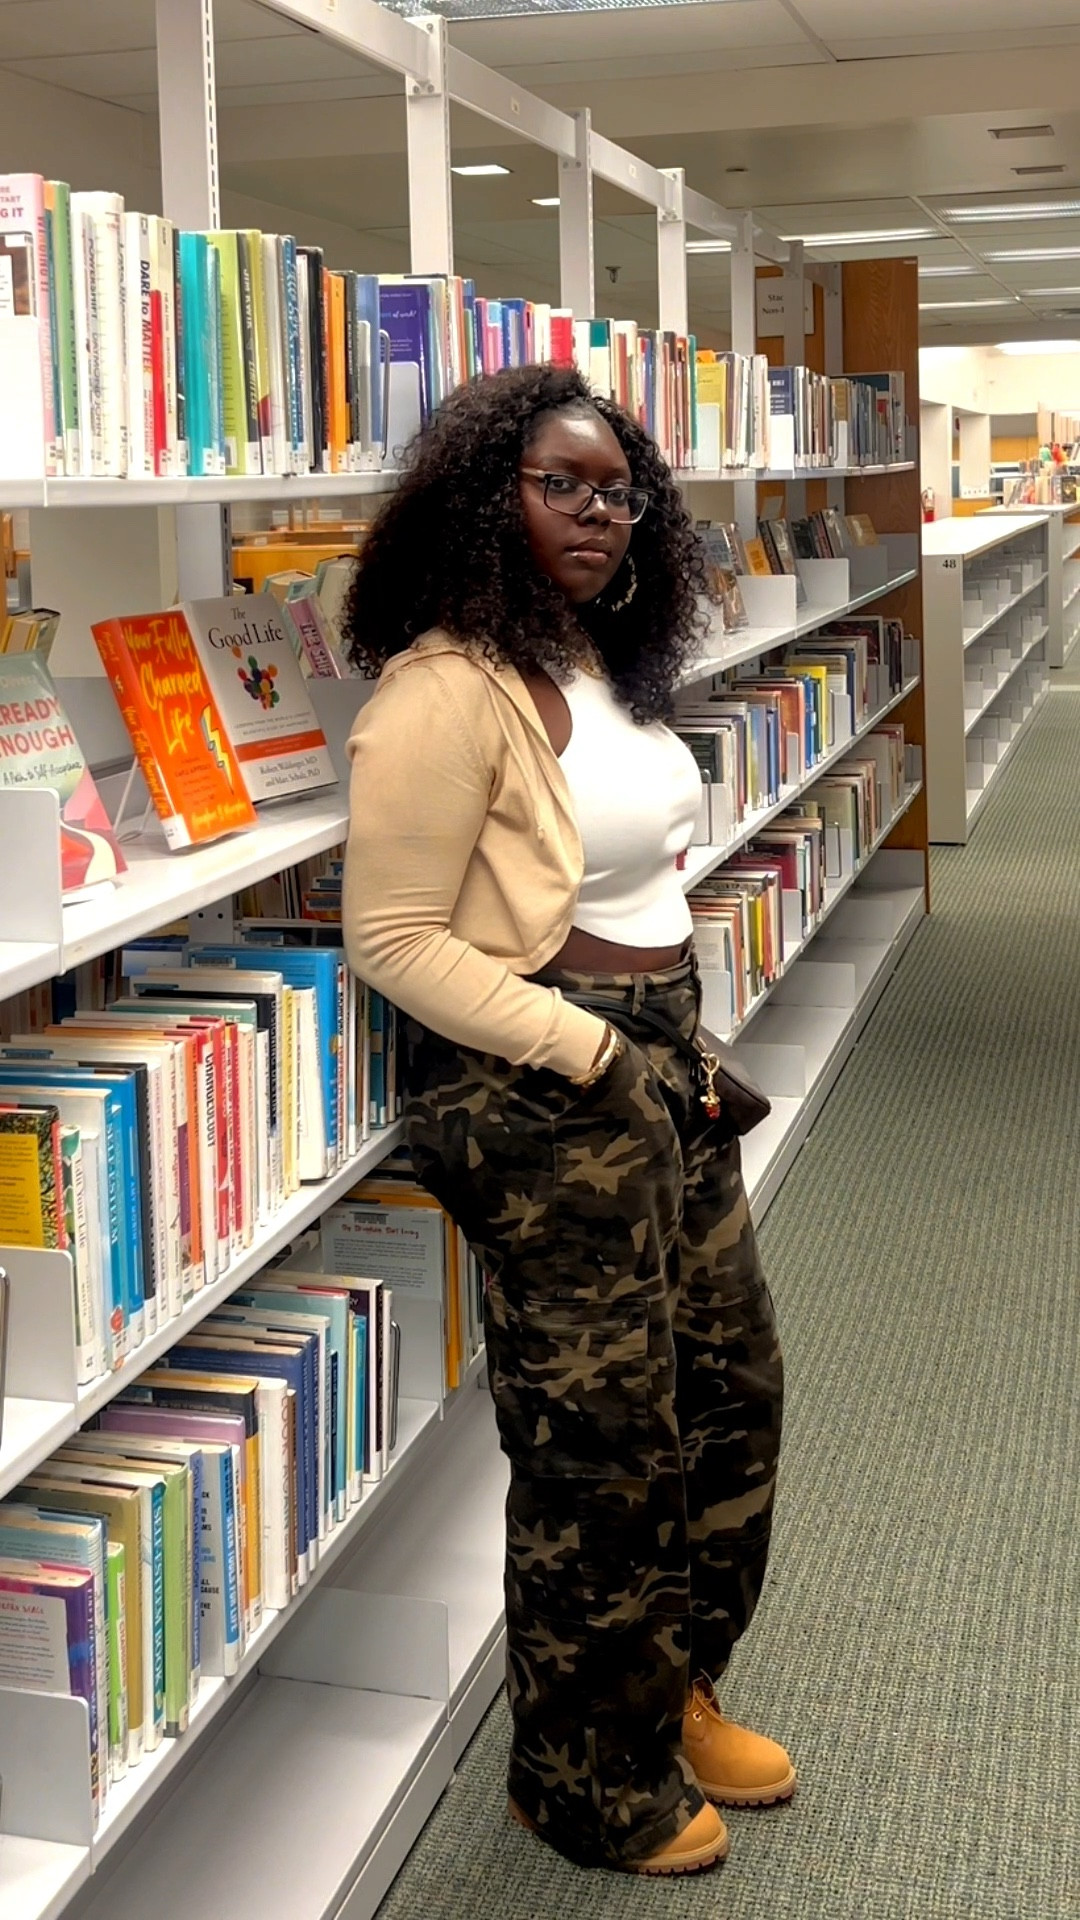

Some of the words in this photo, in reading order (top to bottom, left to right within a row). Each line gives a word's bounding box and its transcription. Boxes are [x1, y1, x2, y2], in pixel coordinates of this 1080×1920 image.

[12, 207, 24, 218] IT
[87, 237, 98, 320] POWERSHIFT
[139, 258, 151, 297] DARE
[243, 269, 251, 293] JIM
[141, 301, 150, 315] to
[244, 295, 253, 330] KWIK
[140, 319, 153, 374] MATTER
[92, 331, 102, 398] DAYMOND
[94, 400, 103, 438] JOHN
[942, 558, 957, 569] 48
[230, 607, 246, 621] The
[124, 623, 153, 664] Your
[148, 617, 195, 665] Fully
[208, 622, 253, 650] Good
[252, 618, 285, 645] Life
[299, 619, 321, 648] THE
[140, 656, 207, 713] Charged
[0, 696, 62, 727] READY
[158, 700, 195, 756] Life
[0, 724, 75, 758] NOUGH
[205, 1052, 216, 1149] CHANGEOLOGY
[74, 1158, 87, 1188] Edit
[171, 1153, 180, 1198] Agency
[76, 1189, 87, 1219] Your
[78, 1222, 88, 1249] Life
[130, 1205, 138, 1241] MORIN
[280, 1394, 290, 1457] LOOK
[226, 1514, 234, 1549] SEVEN
[152, 1504, 164, 1622] SELF-ESTEEM
[228, 1550, 236, 1585] TOOLS
[229, 1585, 237, 1608] FOR
[230, 1607, 238, 1633] LIFE
[153, 1623, 165, 1686] BOOK
